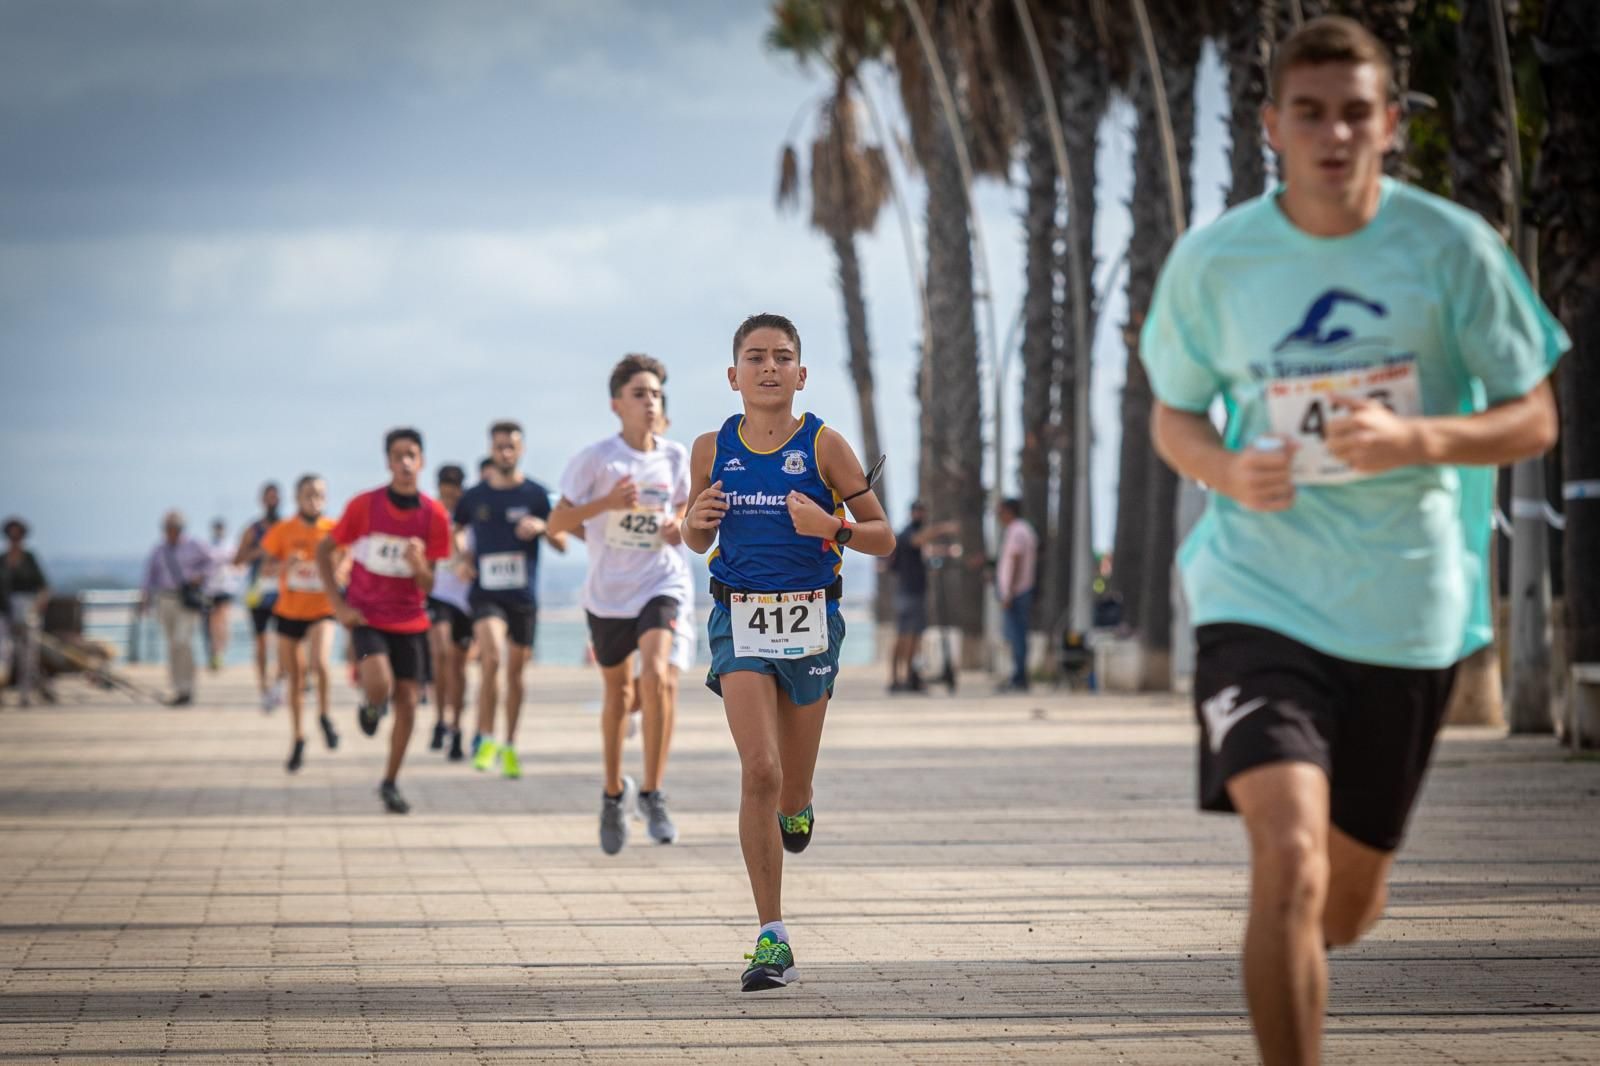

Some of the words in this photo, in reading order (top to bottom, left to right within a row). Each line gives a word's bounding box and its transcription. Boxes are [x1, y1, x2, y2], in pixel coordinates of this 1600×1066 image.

[725, 490, 787, 506] Tirabuz
[619, 514, 660, 535] 425
[748, 605, 810, 635] 412
